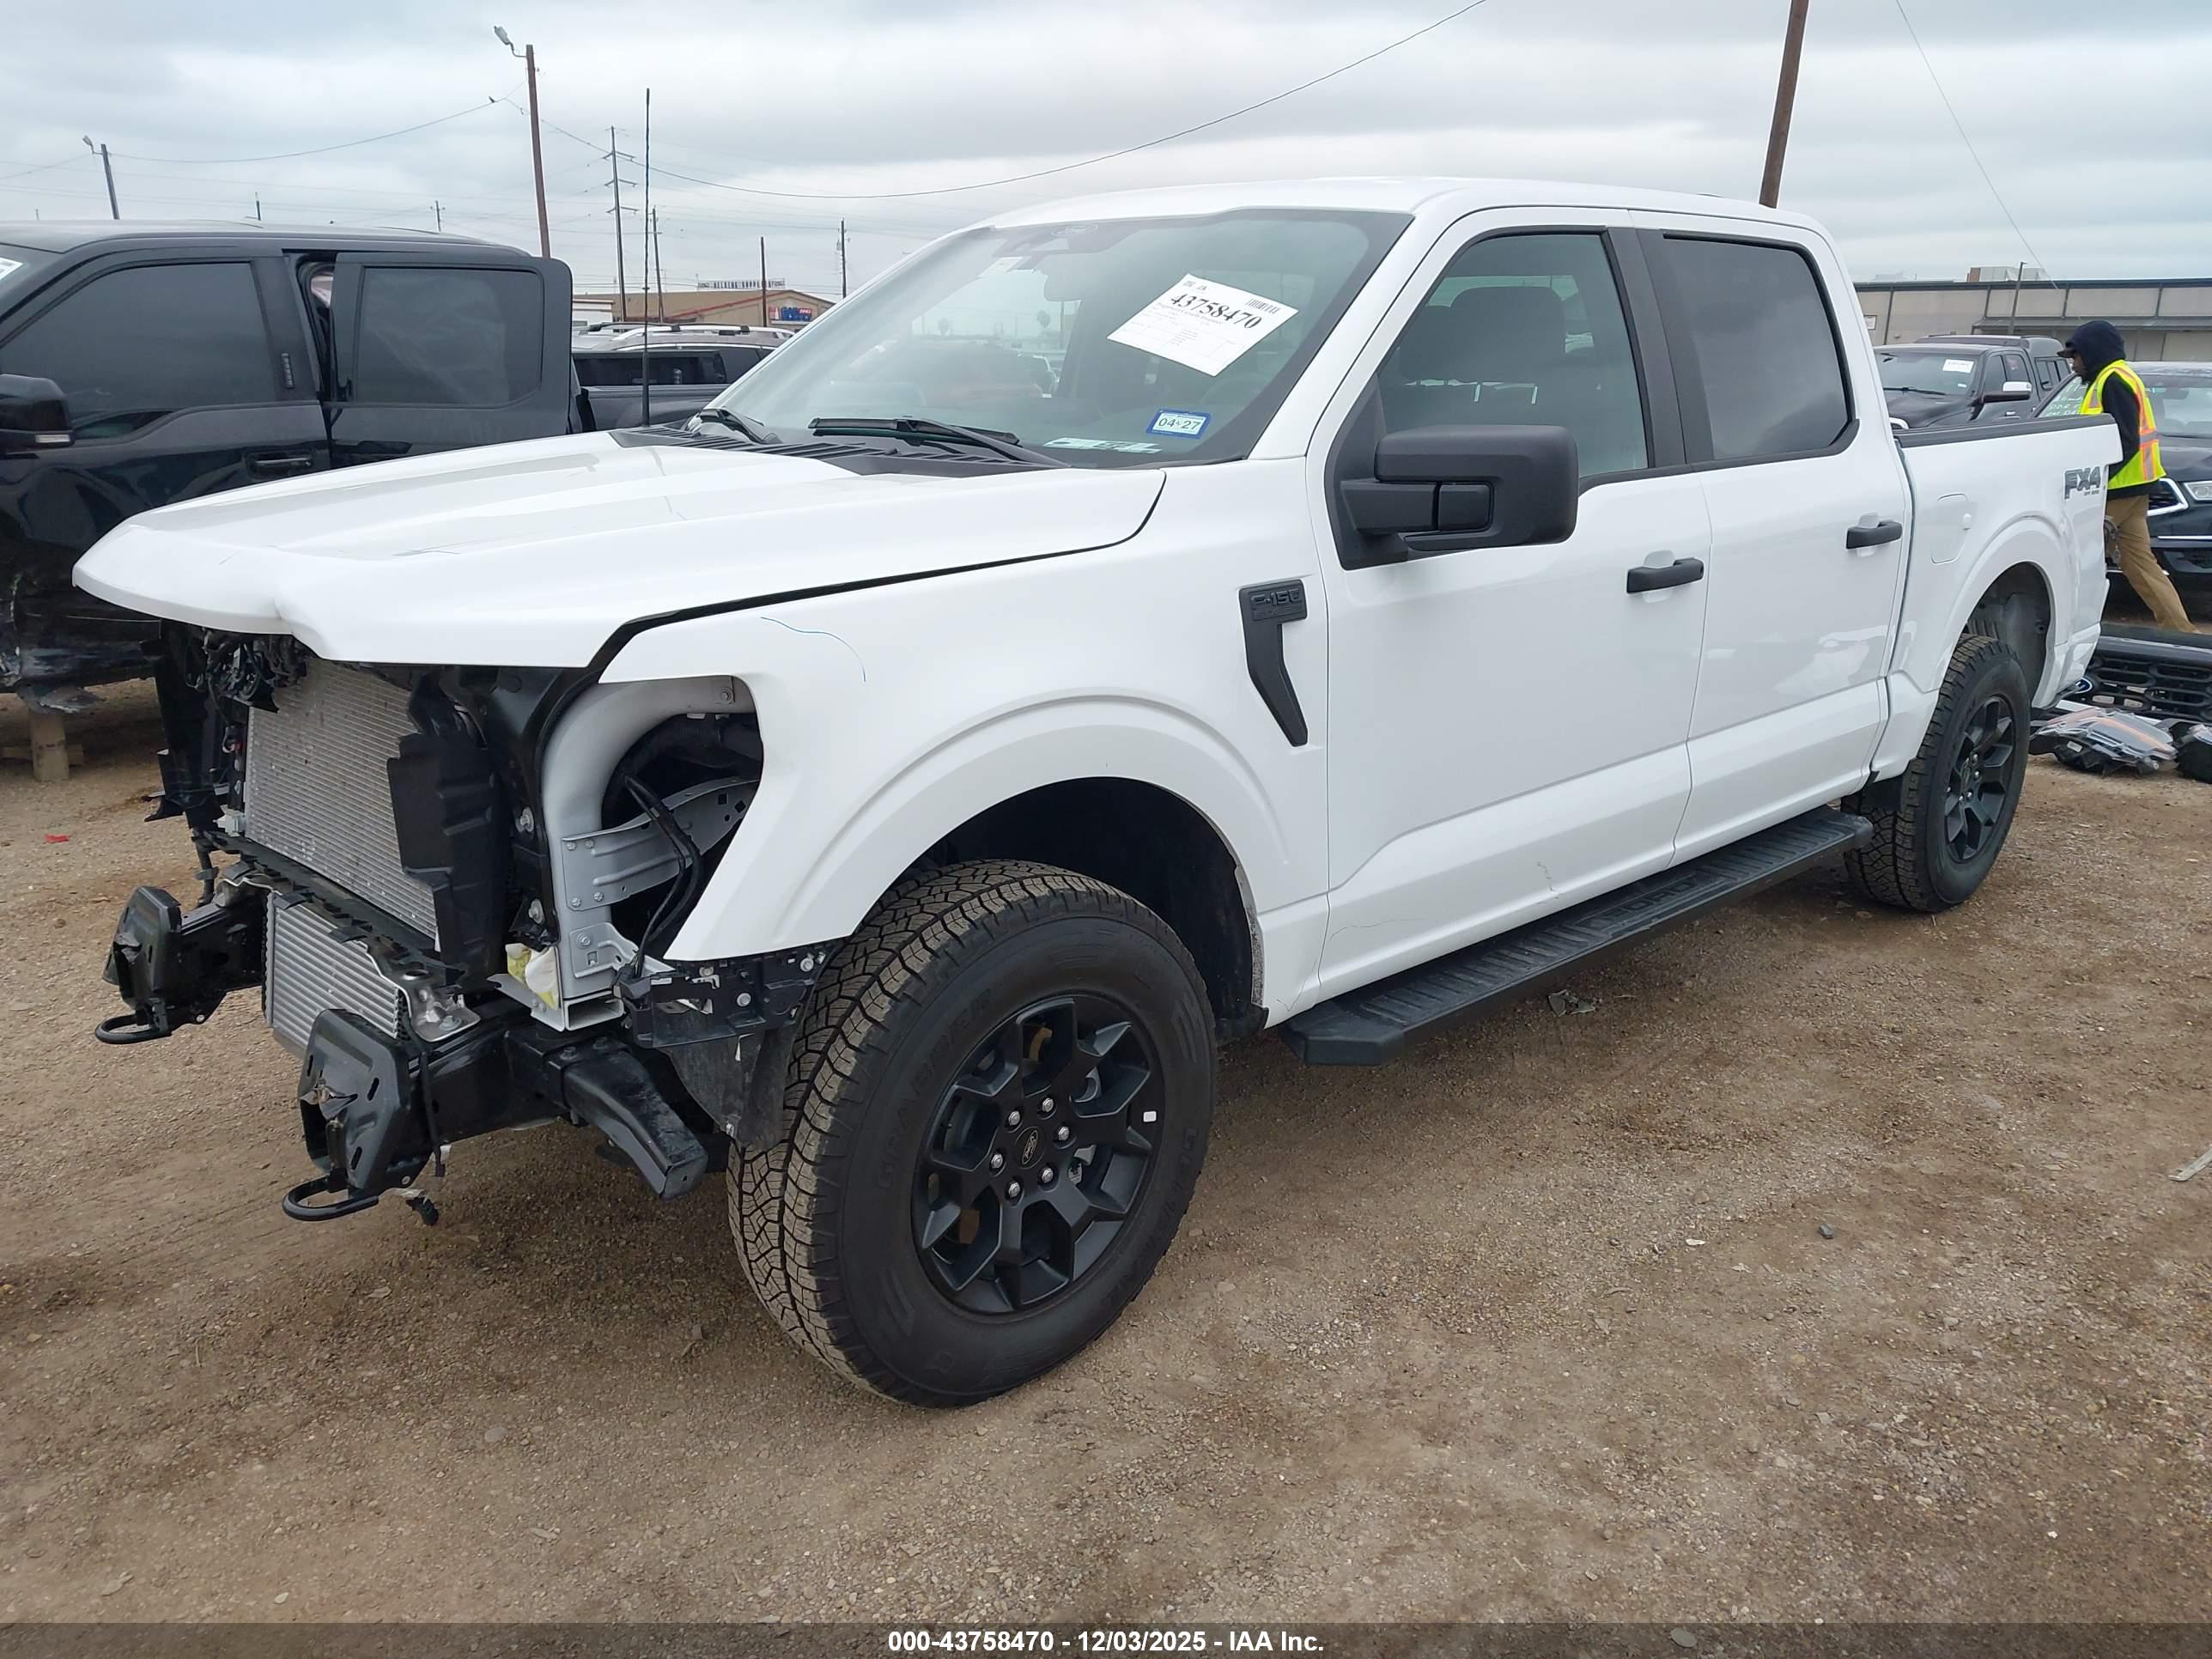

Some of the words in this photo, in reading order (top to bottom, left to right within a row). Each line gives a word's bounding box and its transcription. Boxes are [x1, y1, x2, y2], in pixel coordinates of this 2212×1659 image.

[1170, 294, 1262, 329] 43758470
[1158, 417, 1176, 428] 04
[1182, 420, 1201, 430] 27
[2064, 466, 2101, 499] FX4
